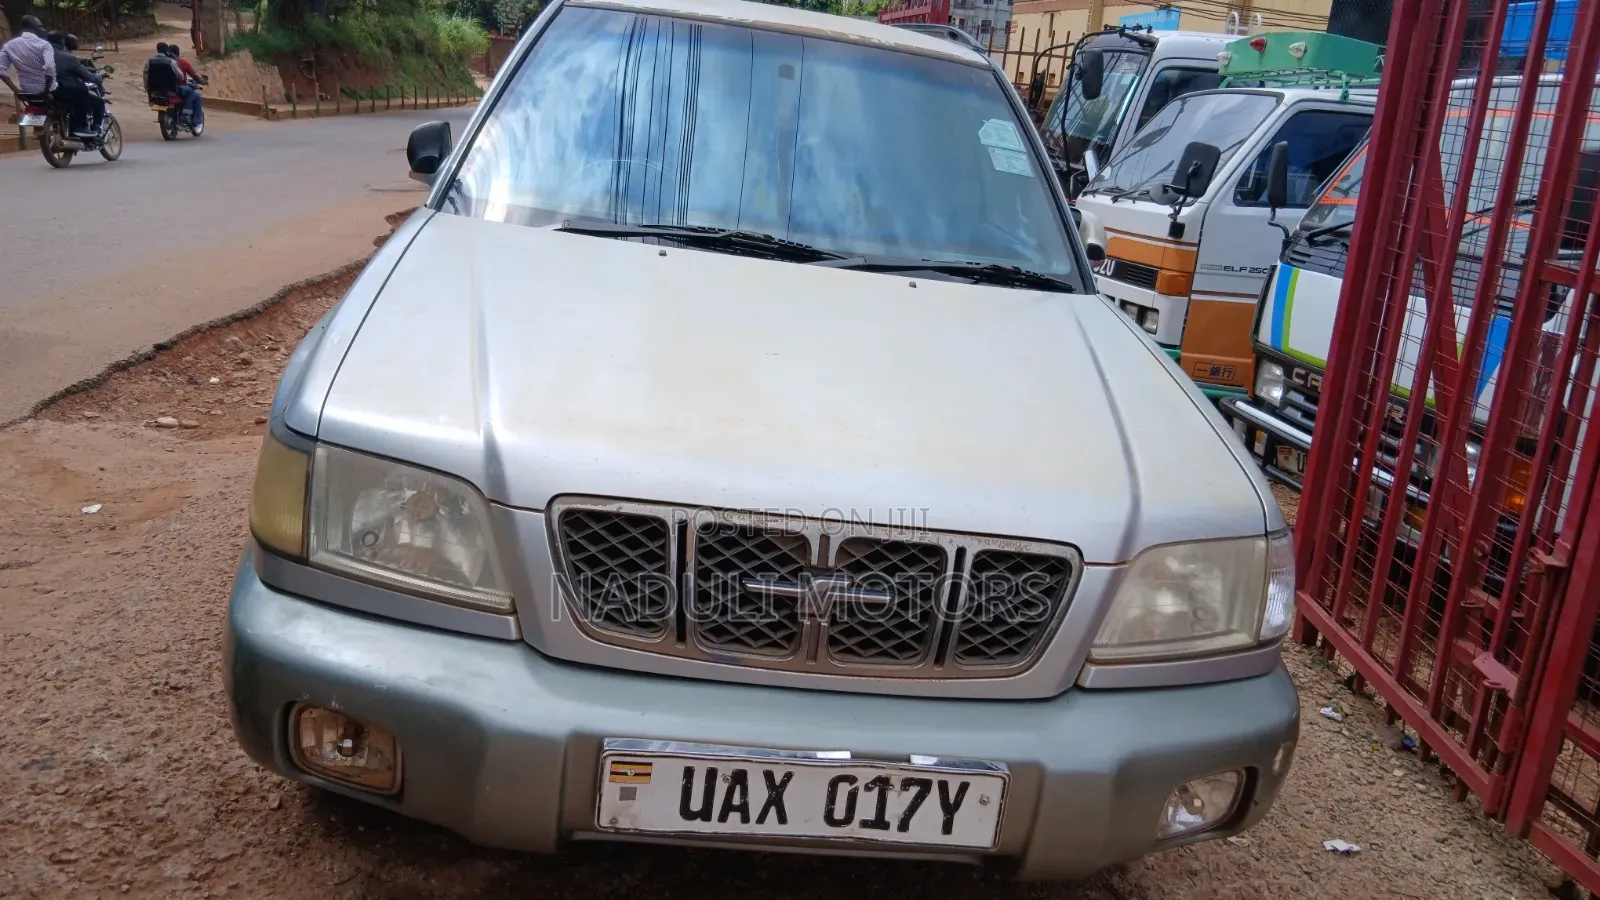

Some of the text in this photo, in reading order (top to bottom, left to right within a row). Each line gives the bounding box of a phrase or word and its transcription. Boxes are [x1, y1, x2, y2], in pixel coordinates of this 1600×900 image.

[1093, 258, 1116, 276] ZU
[679, 765, 971, 836] UAX 017Y
